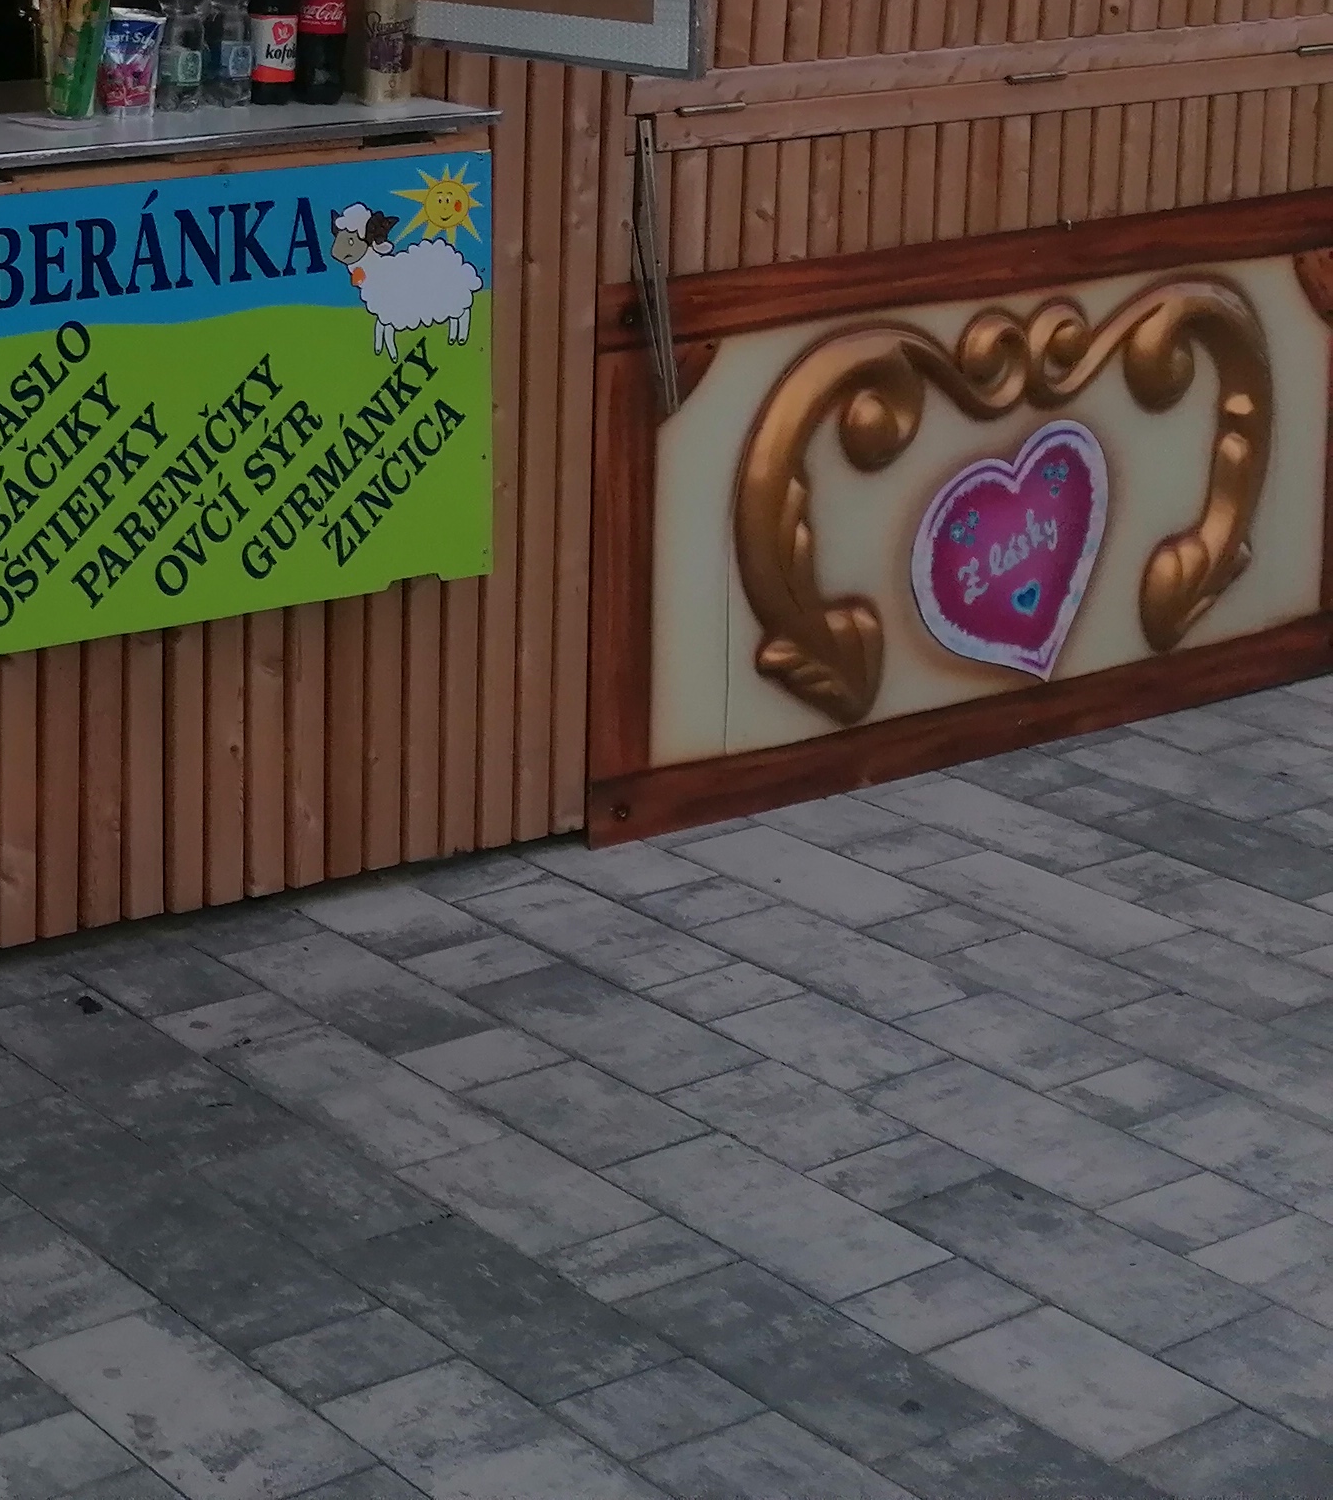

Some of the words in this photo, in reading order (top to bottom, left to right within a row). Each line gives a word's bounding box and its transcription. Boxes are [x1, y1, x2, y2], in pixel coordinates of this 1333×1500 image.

[71, 353, 283, 609] PARENIČKY
[154, 471, 250, 597] OVČÍ
[243, 400, 324, 496] SÝR
[241, 337, 439, 580] GURMÁNKY
[317, 398, 466, 568] ŽINČICA
